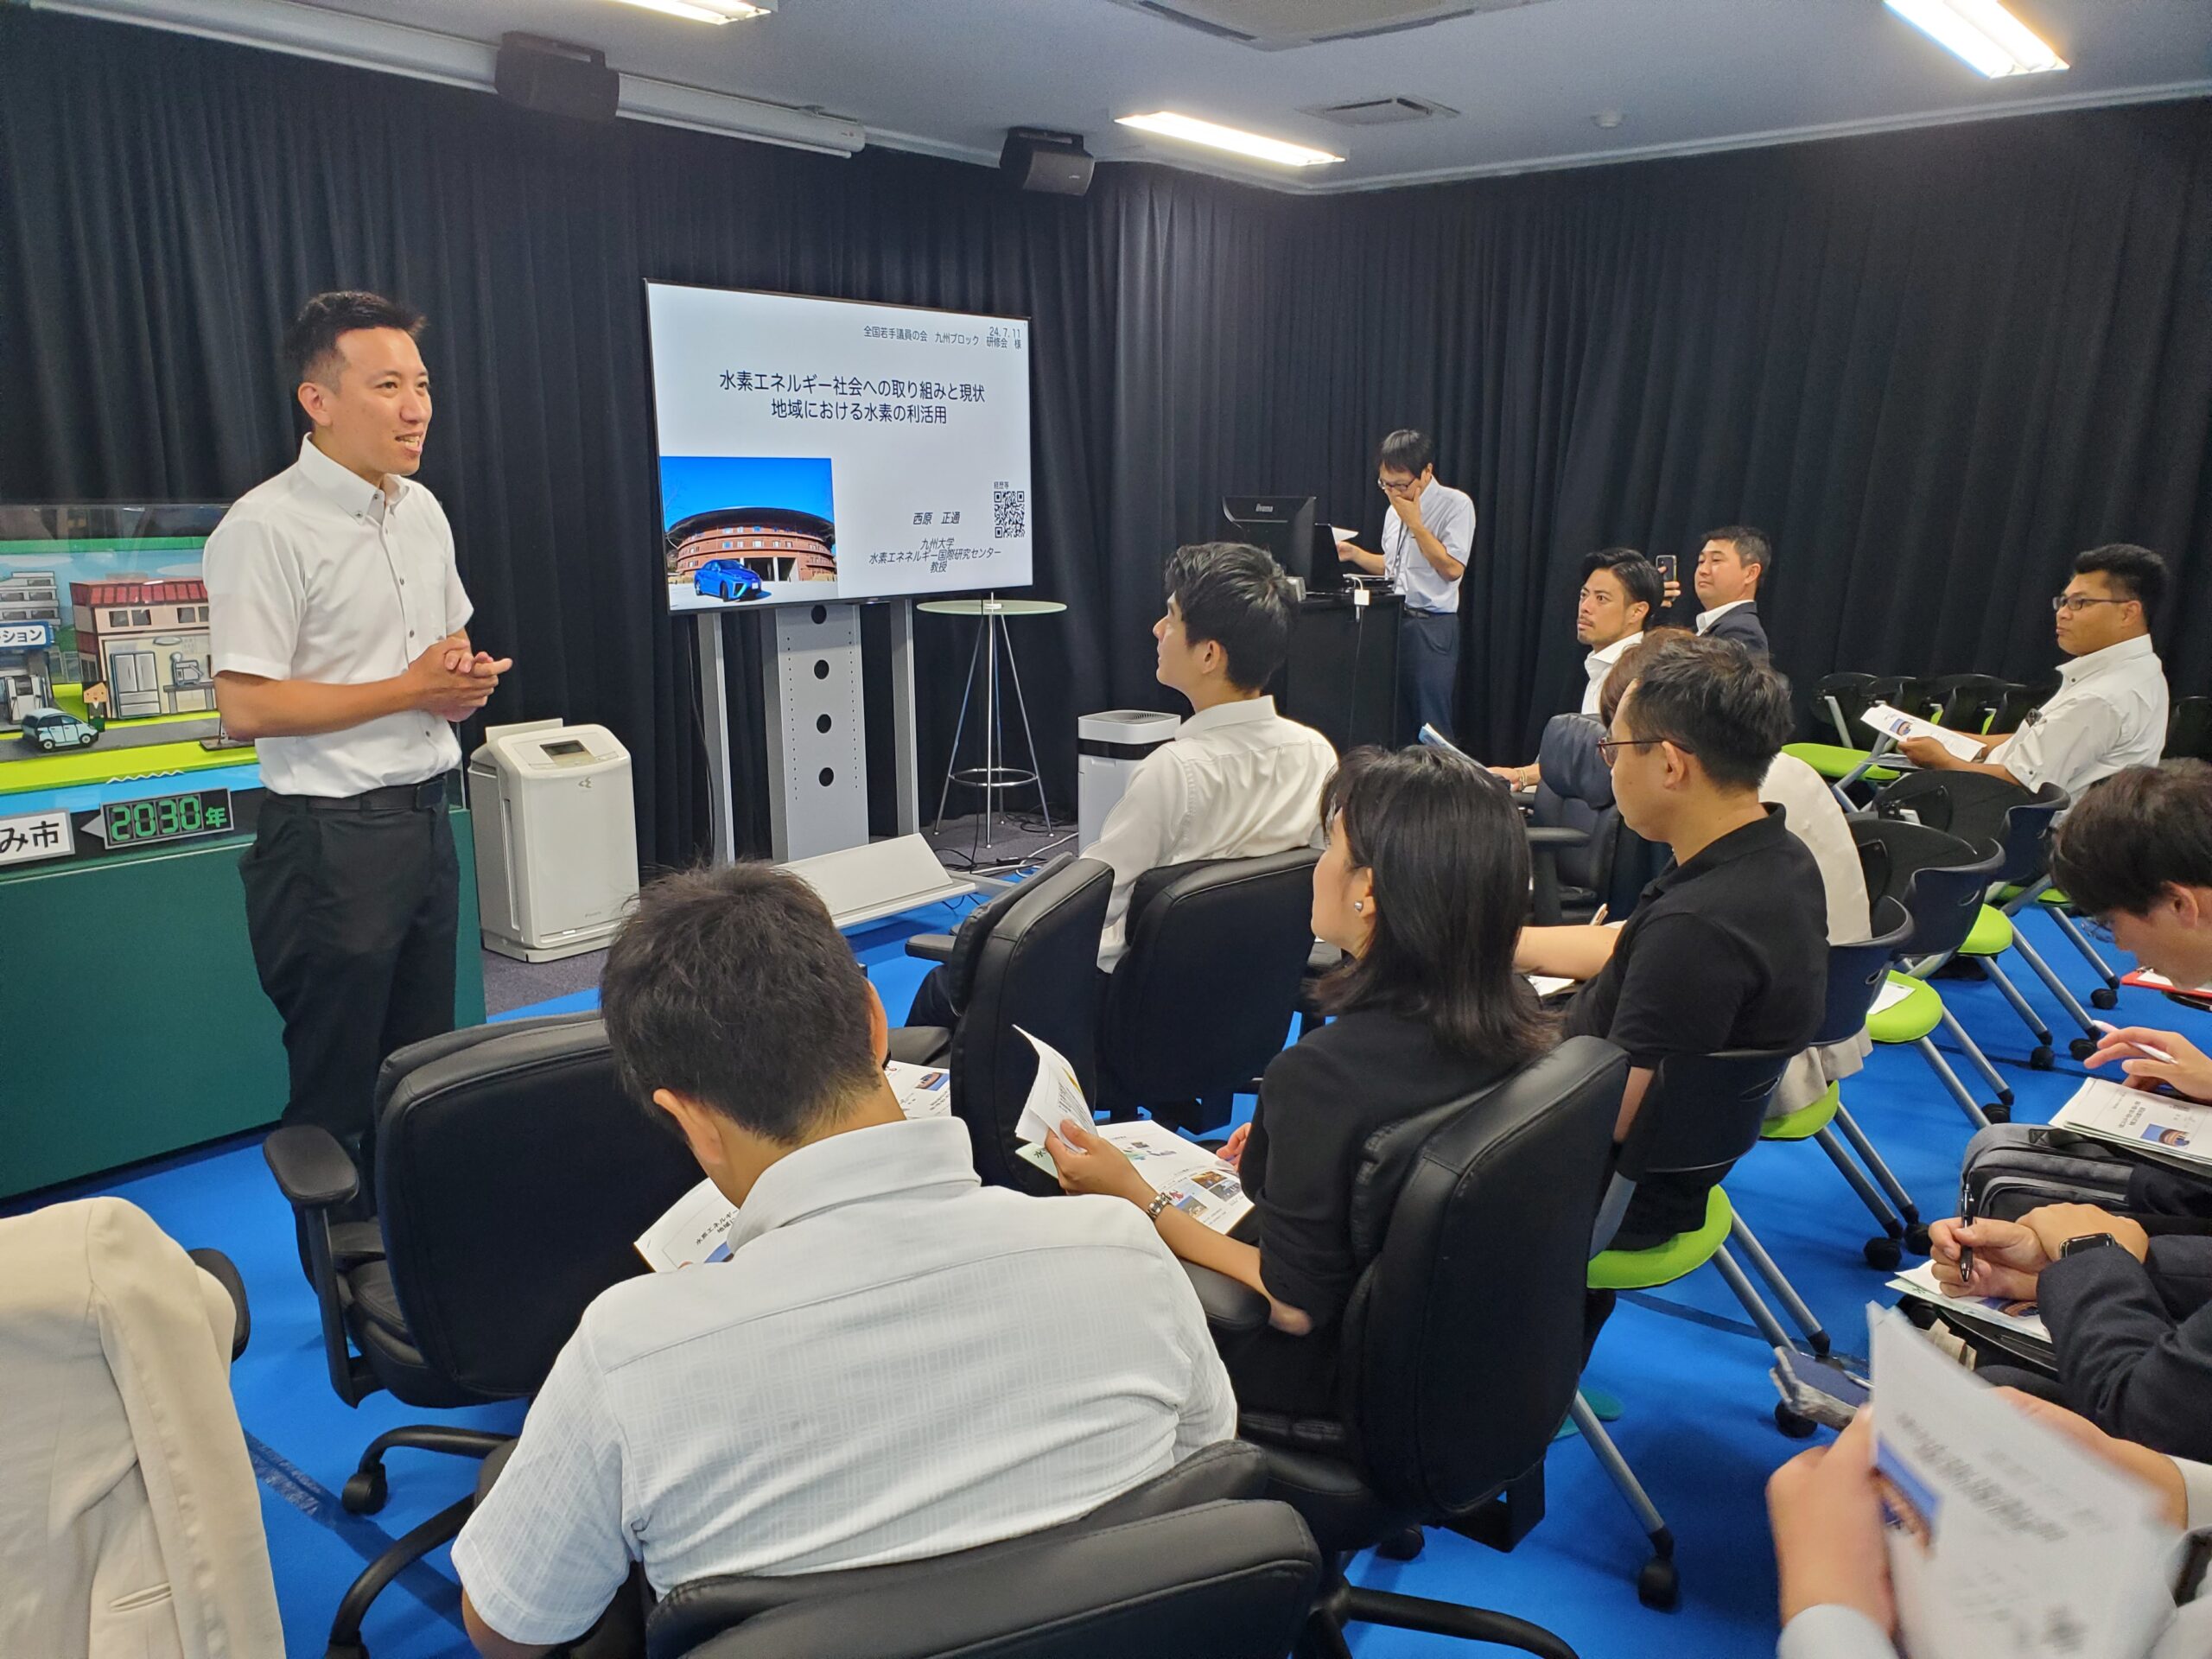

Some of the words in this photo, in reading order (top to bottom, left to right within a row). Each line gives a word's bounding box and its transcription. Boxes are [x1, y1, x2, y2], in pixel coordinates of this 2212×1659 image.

[864, 325, 928, 342] 全国若手議員の会
[935, 332, 979, 346] 九州ブロック
[987, 336, 1008, 348] 研修会
[1014, 338, 1021, 349] 様
[719, 369, 985, 403] 水素エネルギー社会への取り組みと現状
[771, 398, 947, 424] 地域における水素の利活用
[912, 512, 933, 525] 西原
[941, 512, 960, 524] 正通
[920, 537, 954, 552] 九州大学
[930, 561, 947, 573] 教授
[0, 629, 41, 644] ション
[111, 796, 227, 842] 2030年
[0, 821, 60, 854] み市
